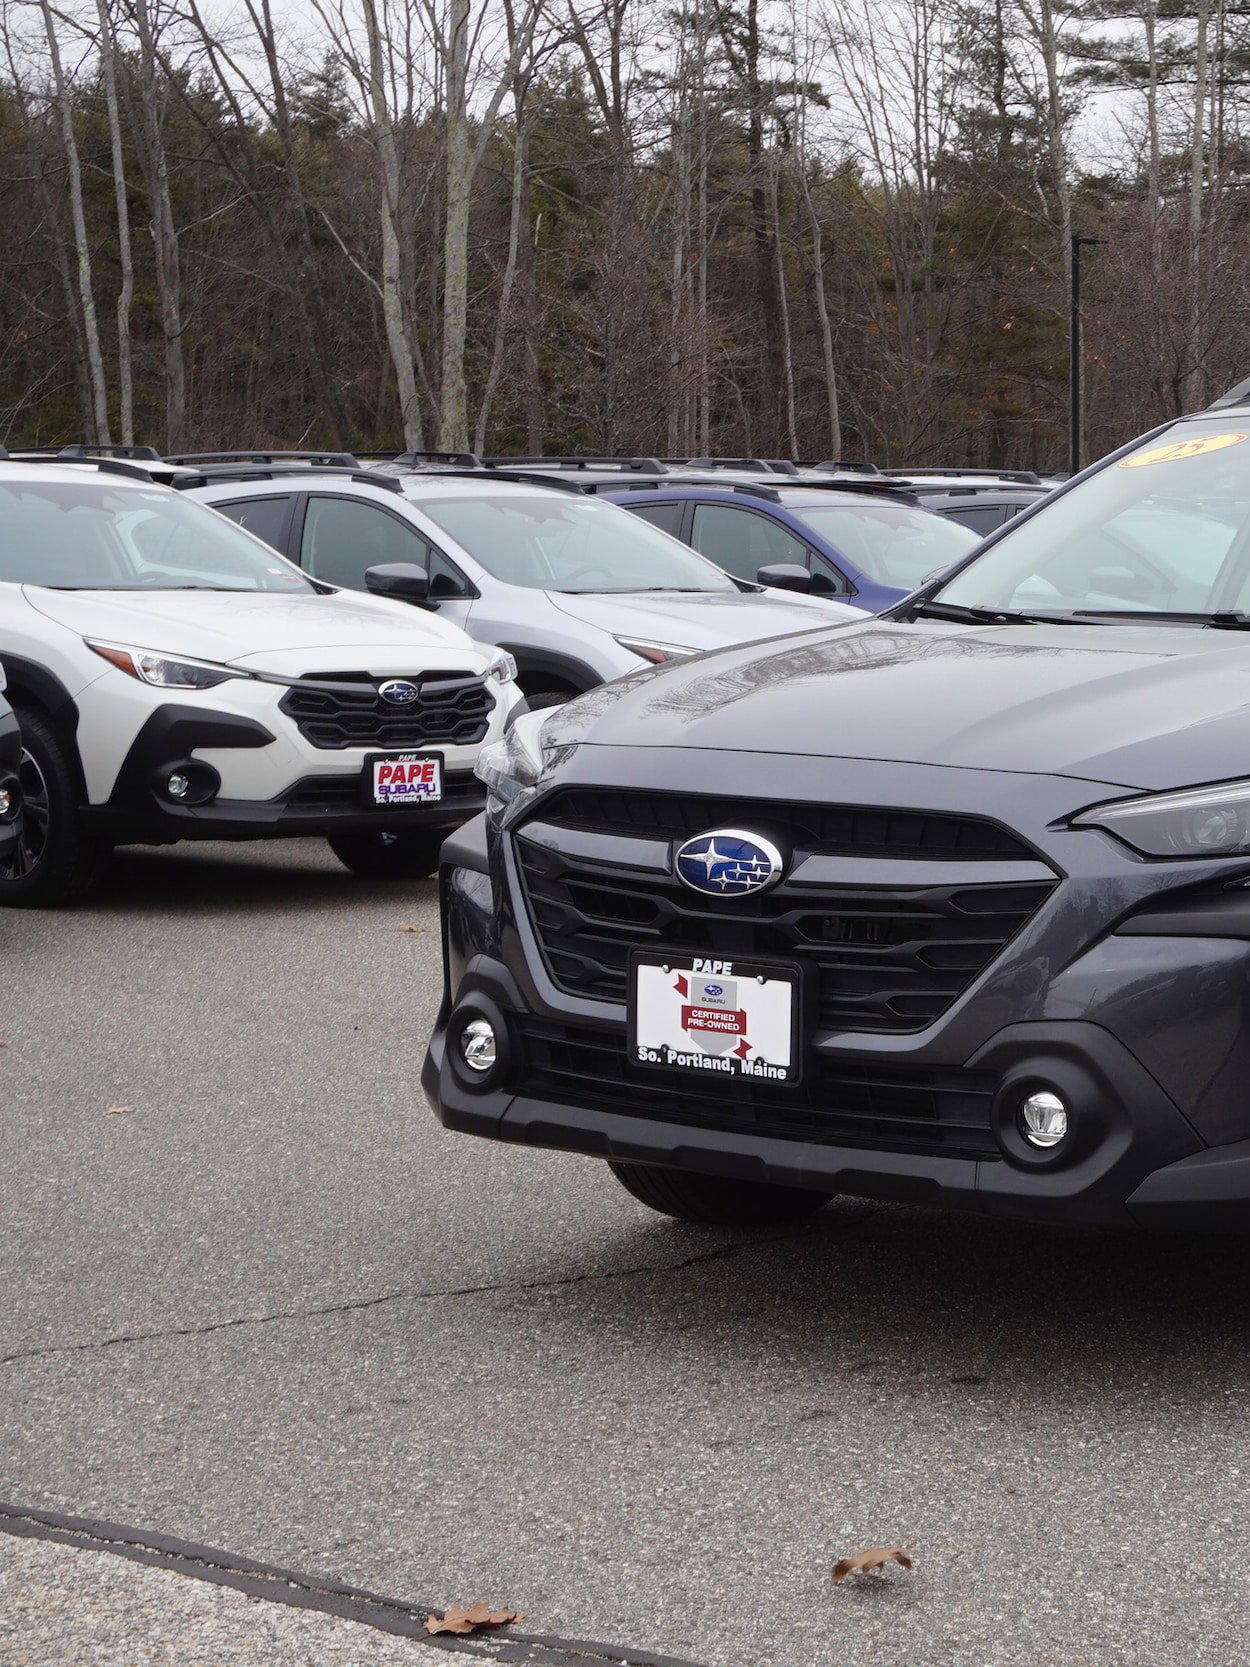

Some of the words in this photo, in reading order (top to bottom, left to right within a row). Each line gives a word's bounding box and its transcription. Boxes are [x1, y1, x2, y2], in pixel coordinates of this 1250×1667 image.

[378, 764, 435, 784] PAPE
[378, 783, 436, 795] SUBARU
[692, 958, 733, 976] PAPE
[691, 1010, 736, 1022] CERTIFIED
[687, 1018, 740, 1031] PRE-OWNED
[637, 1046, 662, 1062] So.
[667, 1050, 735, 1075] Portland,
[740, 1059, 787, 1080] Maine
